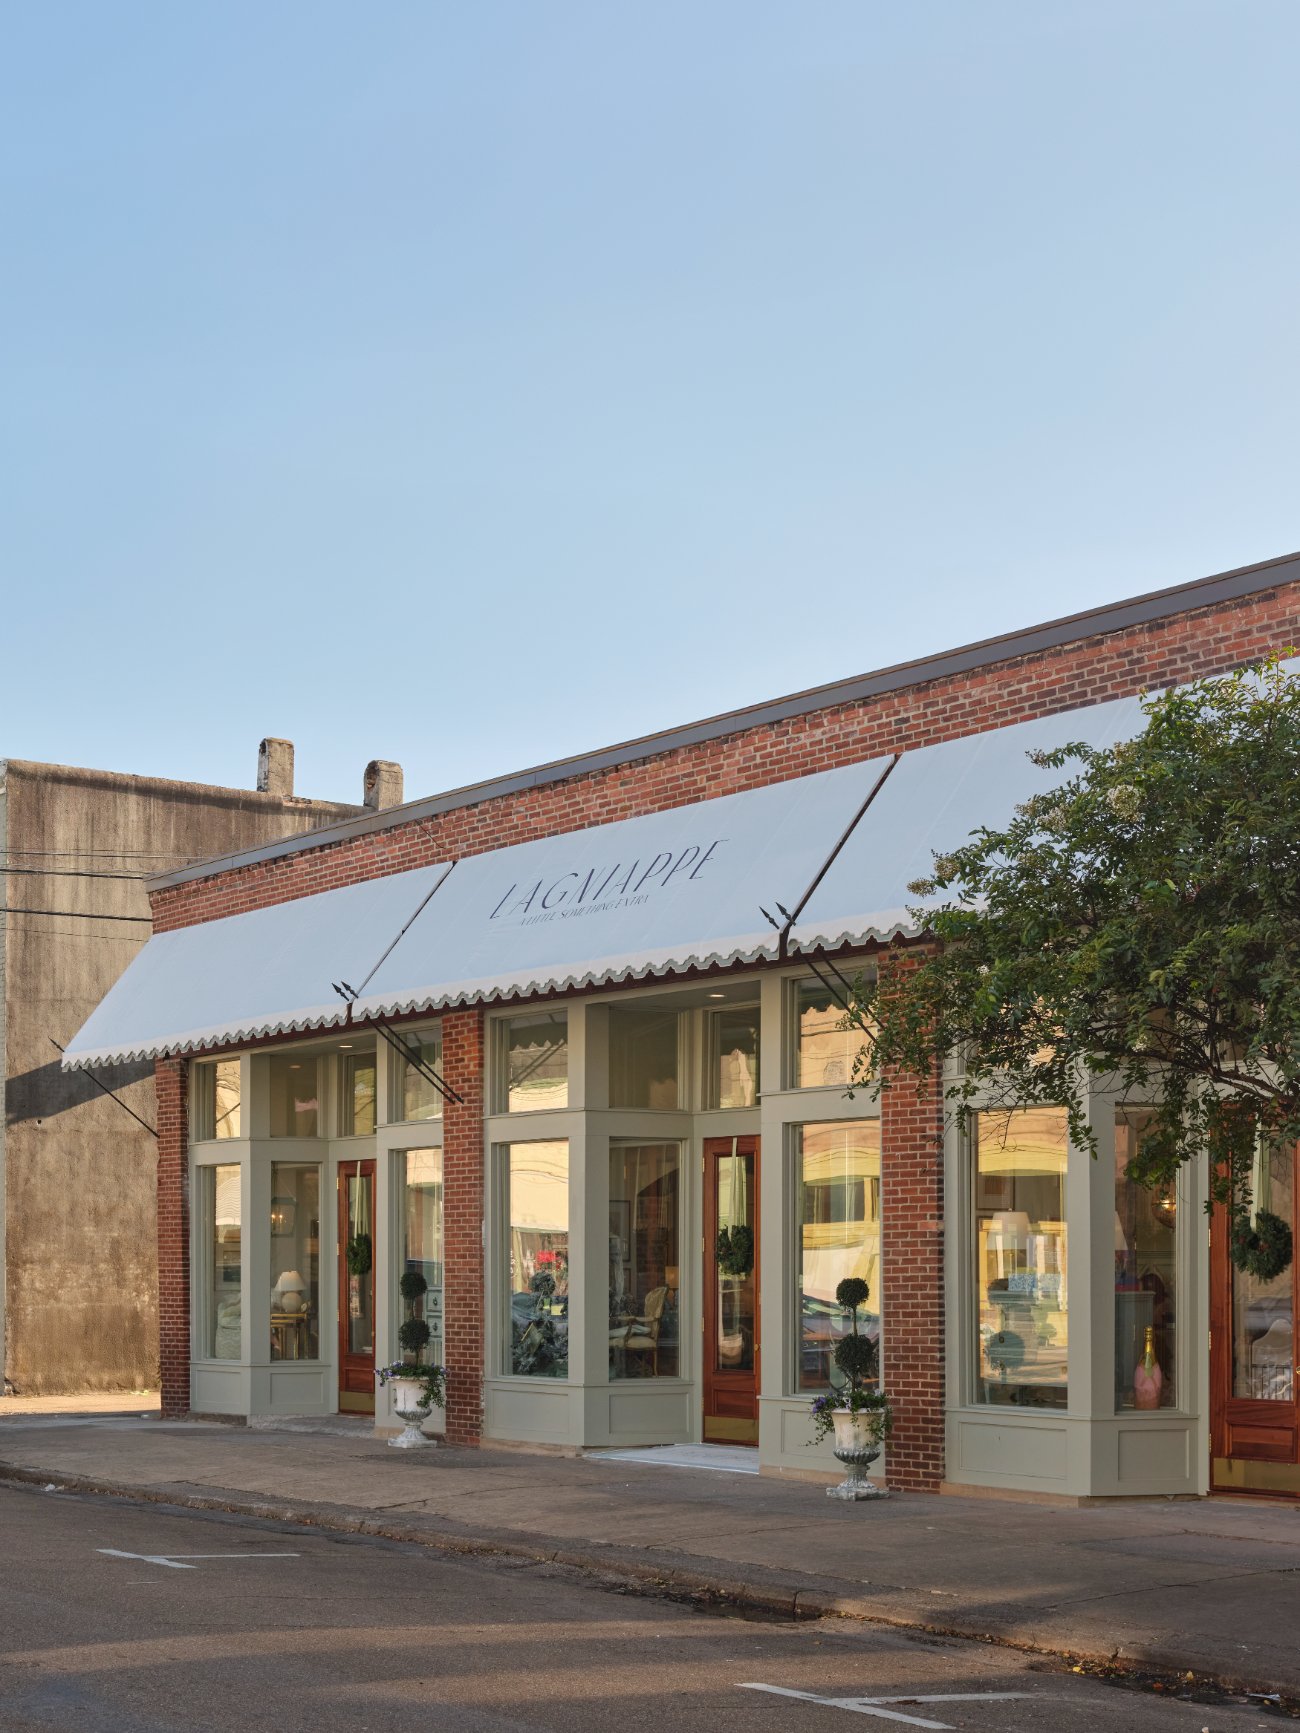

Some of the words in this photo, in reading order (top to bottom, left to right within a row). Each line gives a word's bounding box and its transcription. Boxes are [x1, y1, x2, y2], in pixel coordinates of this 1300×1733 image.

[489, 838, 730, 920] LAGNIAPPE
[560, 902, 614, 919] SOMETHING
[614, 894, 650, 909] EXTRA
